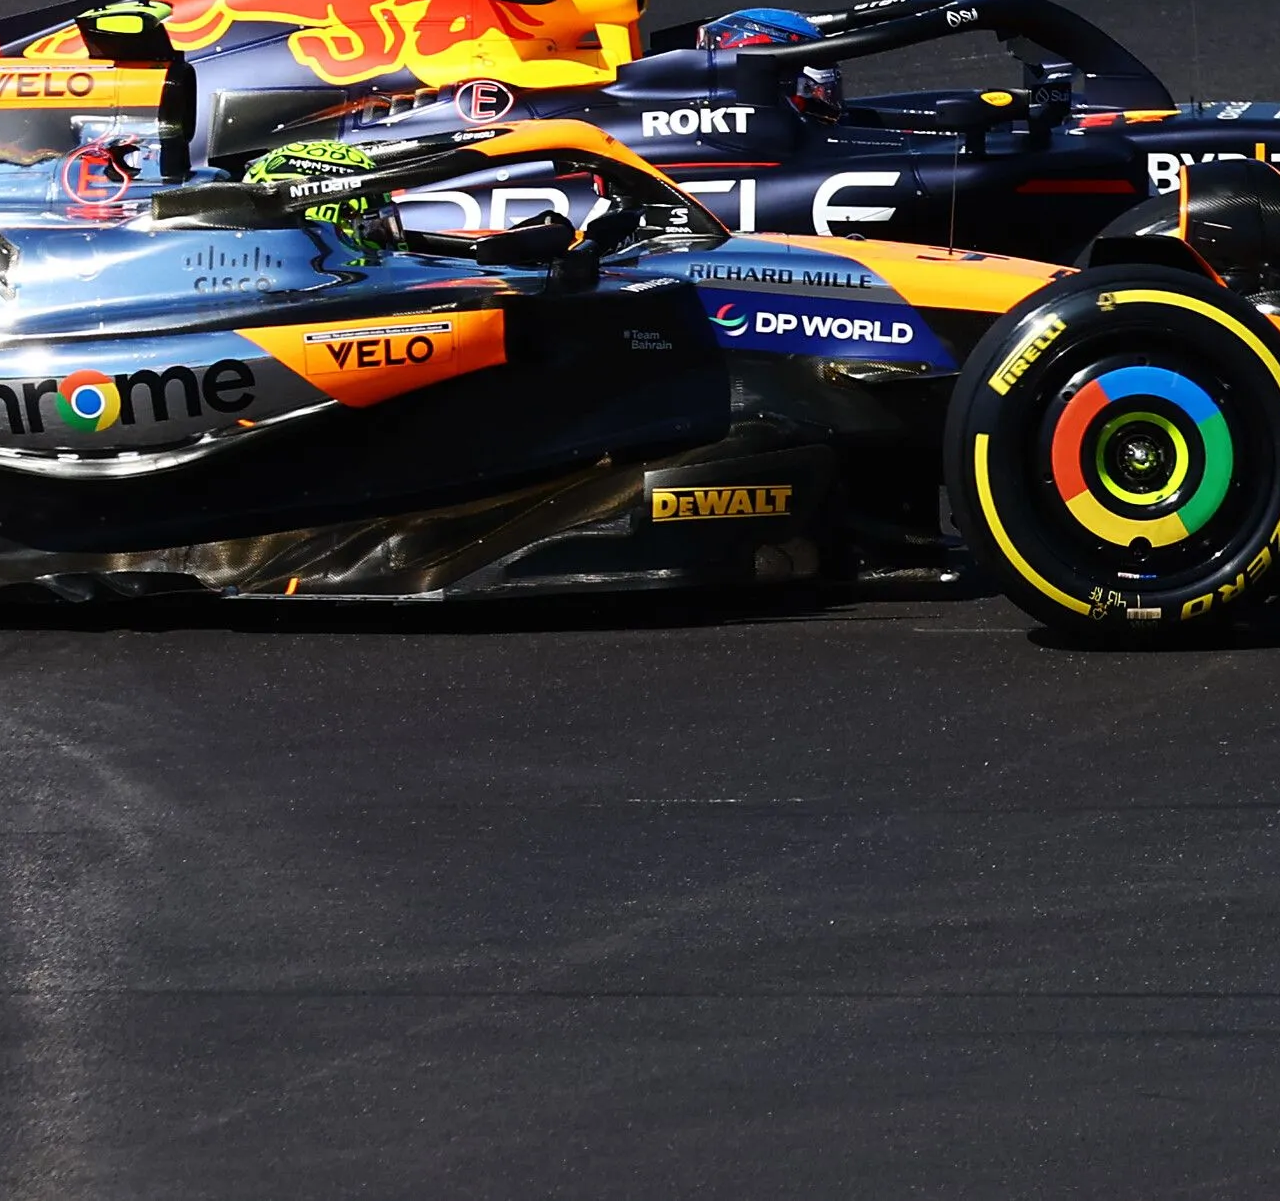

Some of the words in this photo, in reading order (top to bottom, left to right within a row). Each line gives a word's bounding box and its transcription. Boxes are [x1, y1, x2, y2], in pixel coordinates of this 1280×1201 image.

[471, 84, 498, 118] E
[642, 107, 755, 136] ROKT
[290, 182, 319, 198] NTT
[193, 276, 273, 294] CISCO
[688, 262, 793, 284] RICHARD
[800, 270, 872, 289] MILLE
[632, 330, 660, 340] Team
[755, 311, 799, 335] DP
[801, 315, 914, 344] WORLD
[326, 335, 434, 371] VELO
[632, 340, 673, 350] Bahrain
[988, 313, 1067, 396] PIRELLI
[652, 489, 793, 518] DEWALT
